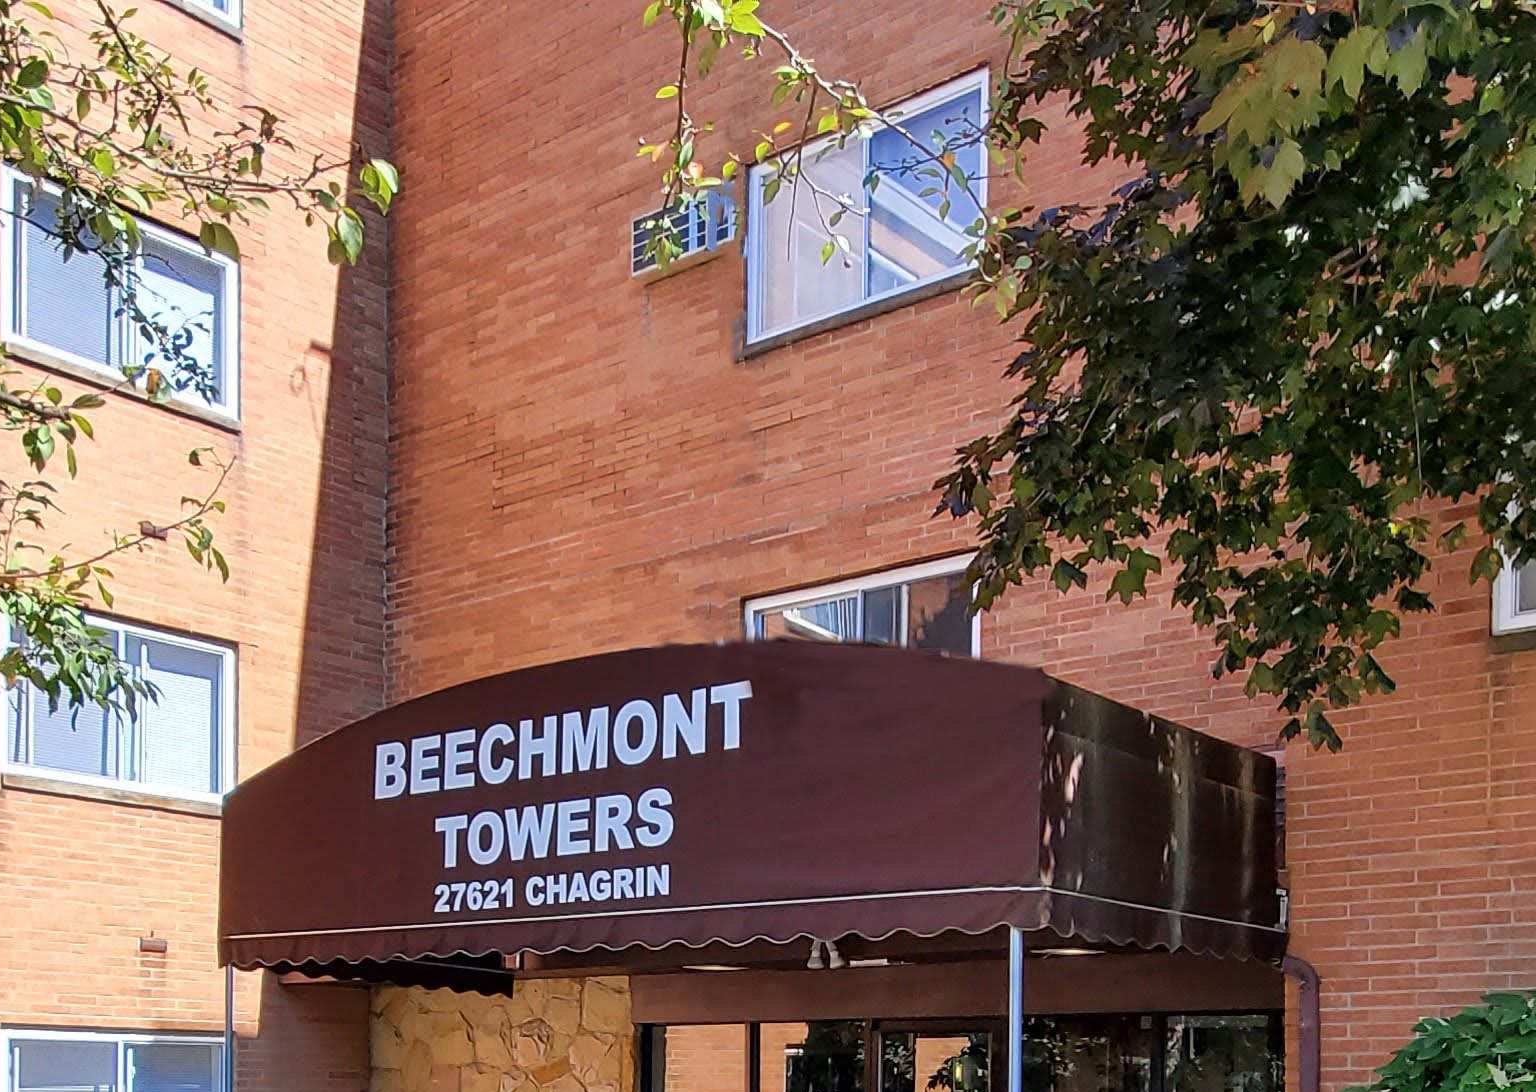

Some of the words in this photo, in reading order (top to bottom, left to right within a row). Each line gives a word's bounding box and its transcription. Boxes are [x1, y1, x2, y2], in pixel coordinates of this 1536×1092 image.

[374, 680, 753, 800] BEECHMONT
[435, 788, 674, 869] TOWERS
[433, 878, 514, 913] 27621
[525, 864, 670, 907] CHAGRIN
